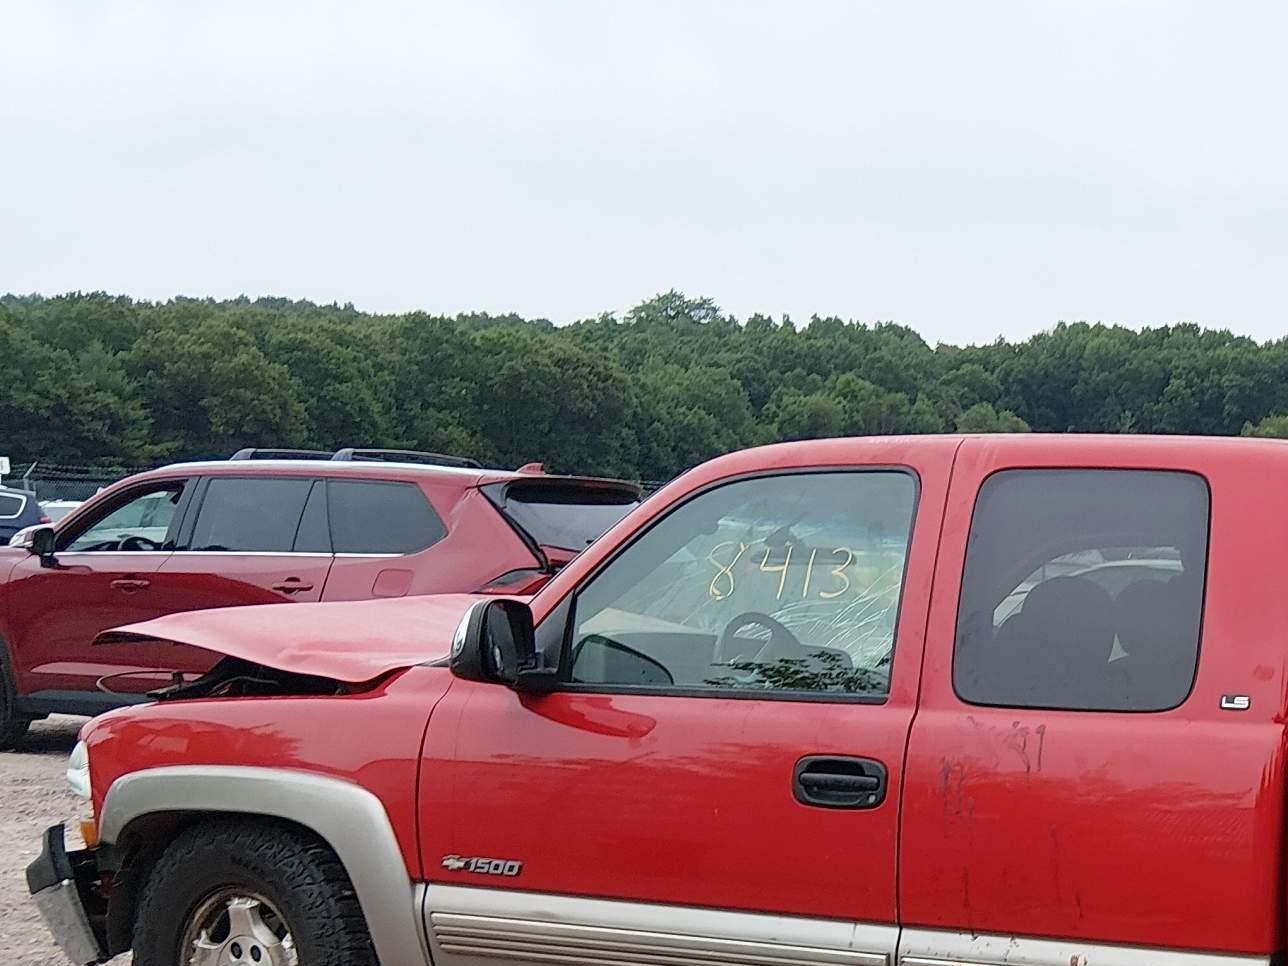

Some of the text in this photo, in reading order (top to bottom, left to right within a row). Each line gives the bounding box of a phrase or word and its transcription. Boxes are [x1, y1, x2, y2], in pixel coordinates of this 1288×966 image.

[706, 541, 852, 600] 8413
[1221, 695, 1250, 709] LS
[467, 857, 522, 876] 1500
